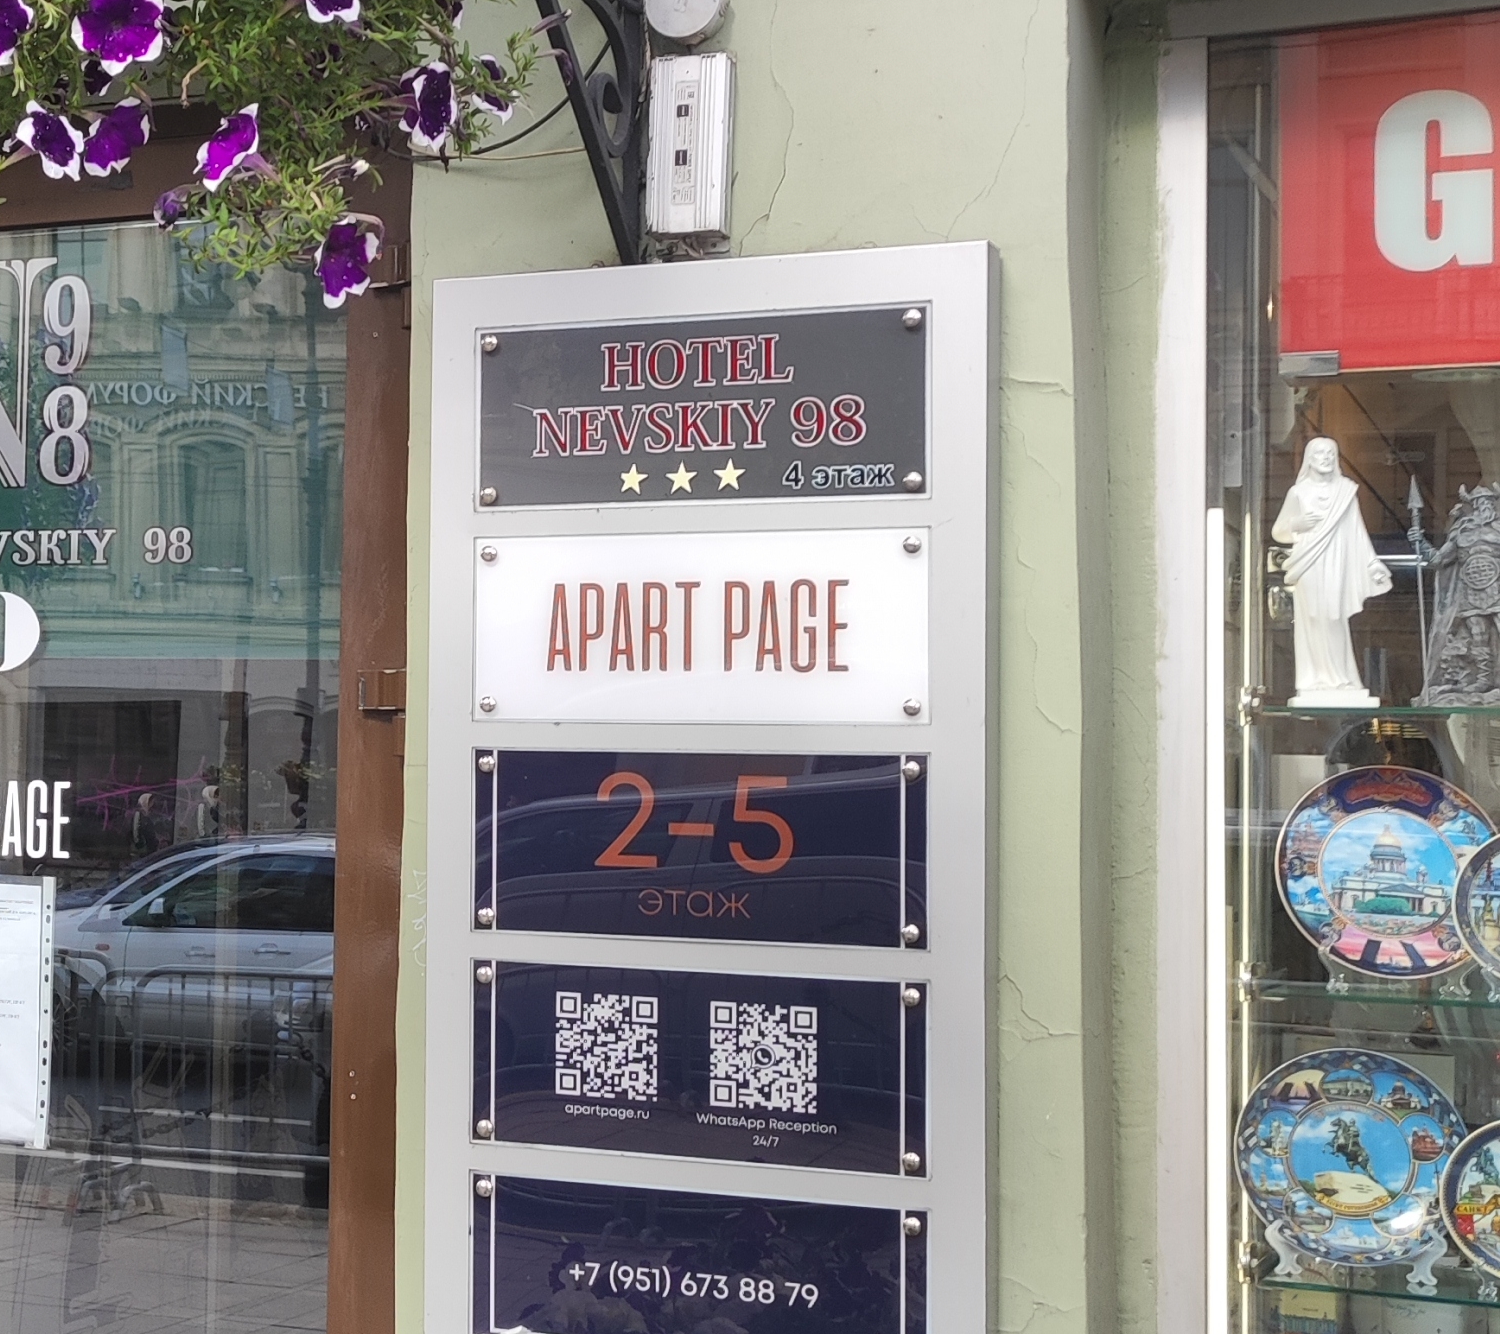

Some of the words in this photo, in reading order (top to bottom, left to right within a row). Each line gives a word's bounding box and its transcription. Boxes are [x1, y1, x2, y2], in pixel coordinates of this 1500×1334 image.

[1374, 90, 1494, 272] G
[601, 334, 793, 391] HOTEL
[531, 399, 775, 458] NEVSKIY
[790, 395, 867, 447] 98
[782, 461, 803, 489] 4
[812, 463, 895, 489] этаж
[142, 526, 194, 565] 98
[546, 580, 701, 672] APART
[722, 579, 850, 673] PAGE
[564, 1103, 650, 1120] apartpage.ru
[696, 1112, 766, 1130] WhatsApp
[769, 1118, 838, 1135] Reception
[752, 1135, 780, 1148] 24/7
[569, 1262, 601, 1286] +7
[609, 1261, 671, 1298] (951)
[680, 1271, 729, 1300] 673
[738, 1277, 776, 1304] 88
[784, 1282, 820, 1309] 79
